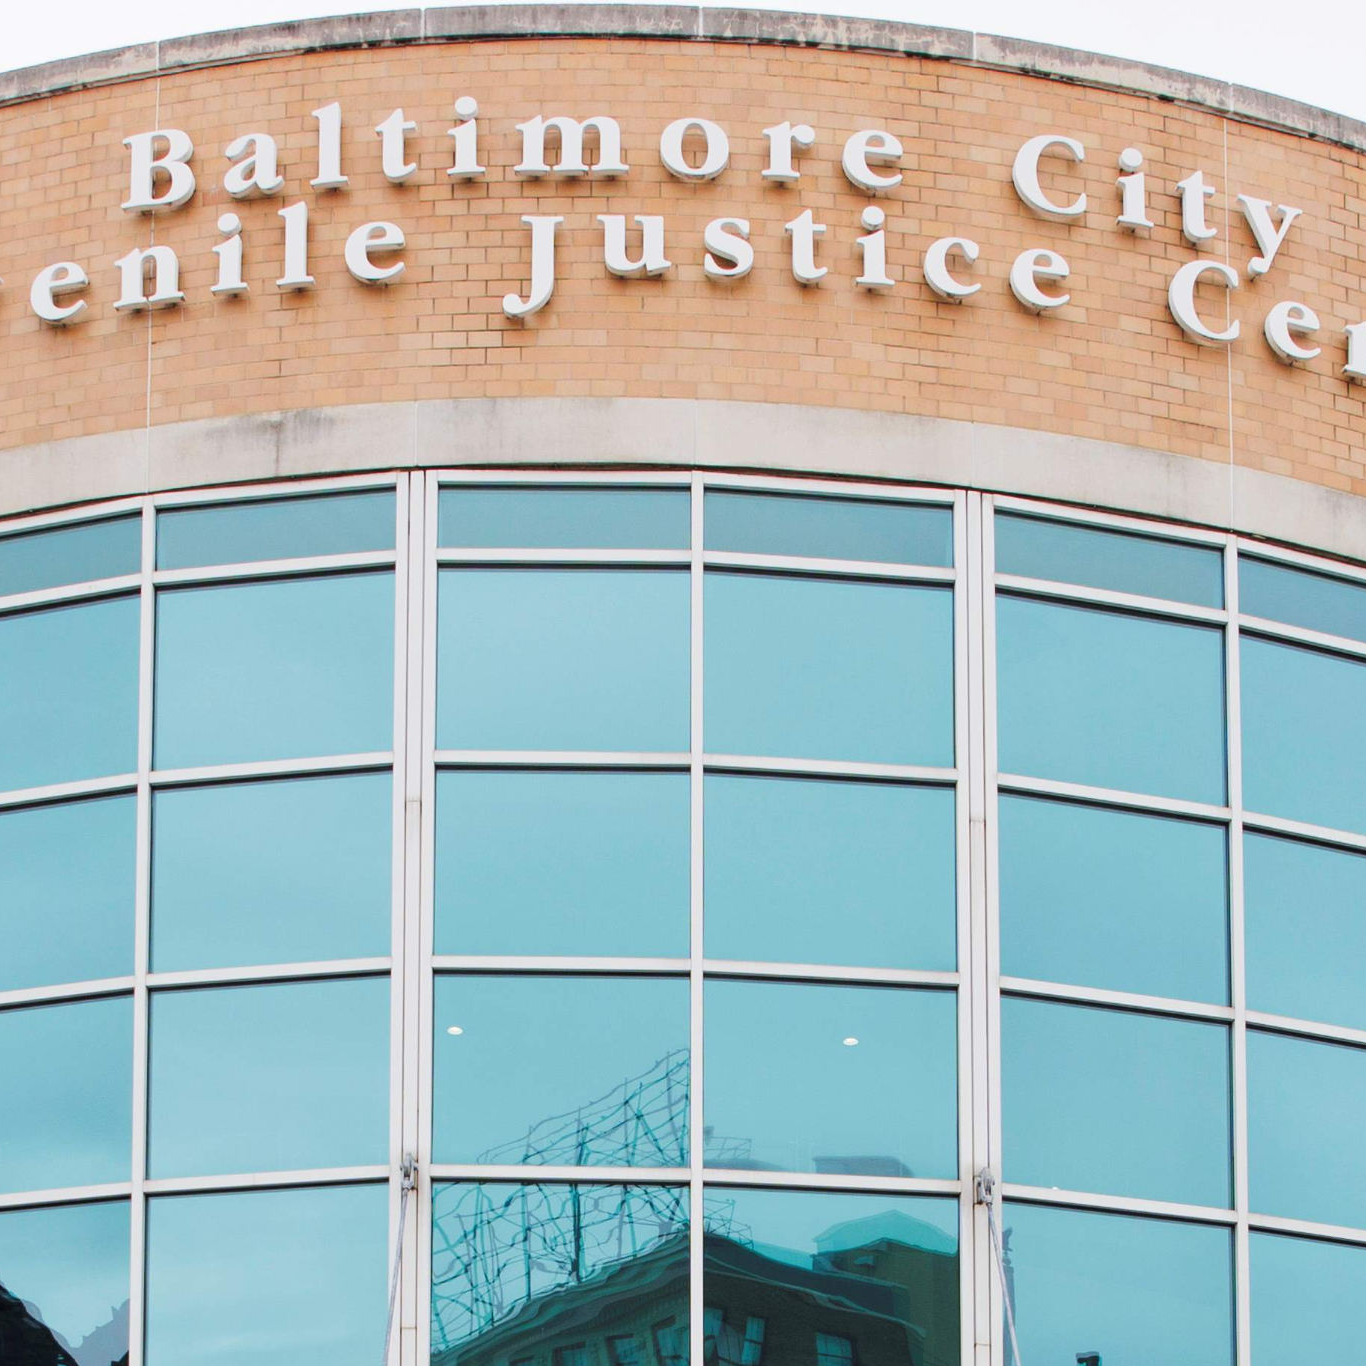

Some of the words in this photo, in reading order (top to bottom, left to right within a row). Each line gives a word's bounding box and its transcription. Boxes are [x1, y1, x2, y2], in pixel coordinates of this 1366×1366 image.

[121, 95, 904, 213] Baltimore
[1012, 134, 1303, 281] City
[502, 205, 1071, 319] Justice
